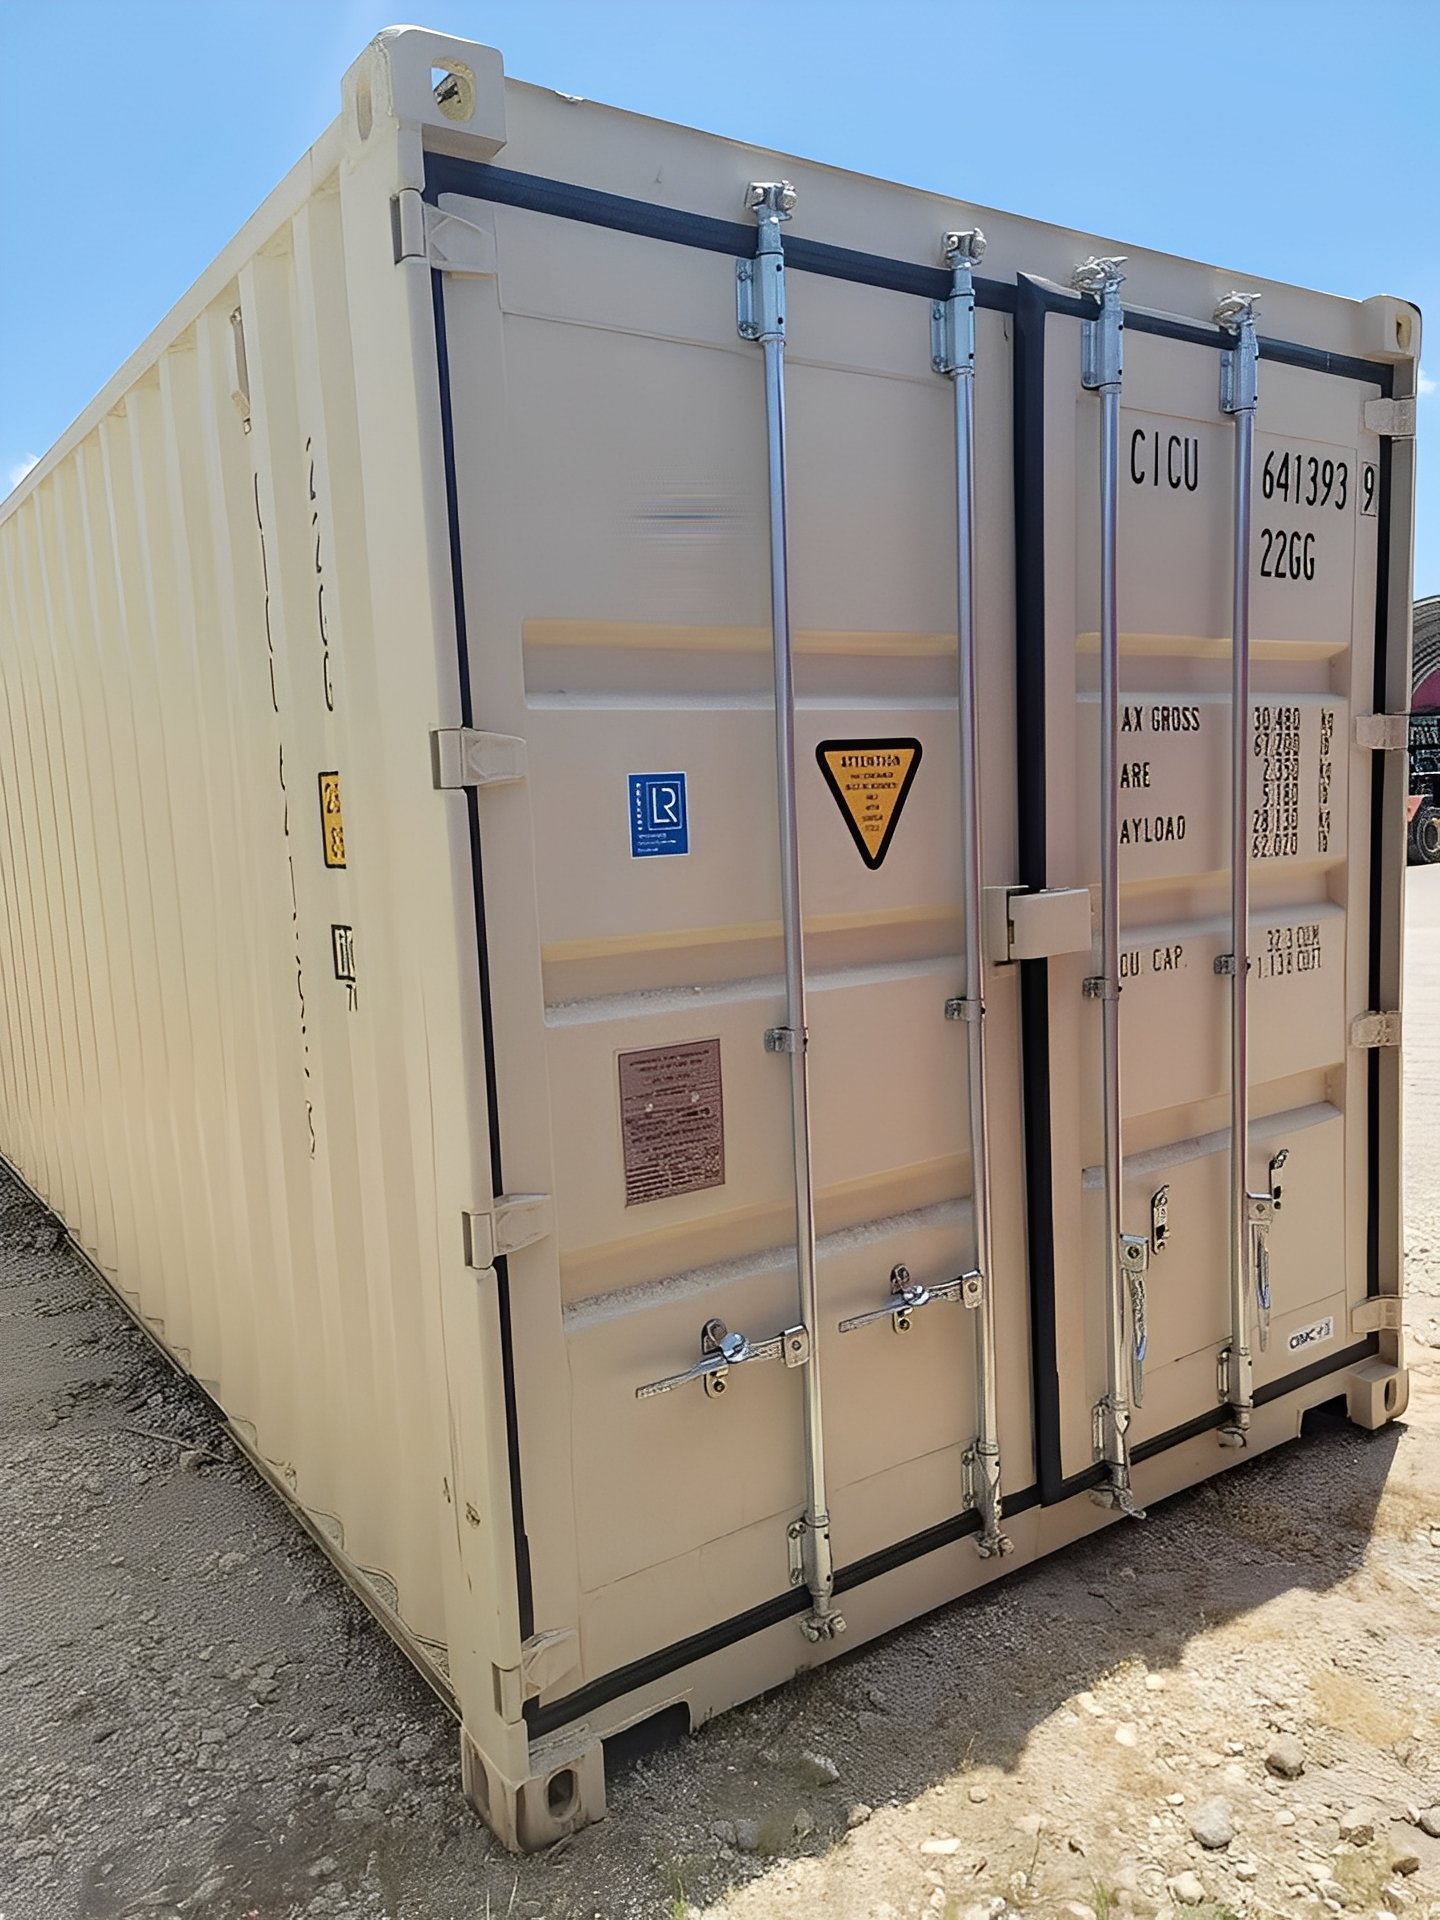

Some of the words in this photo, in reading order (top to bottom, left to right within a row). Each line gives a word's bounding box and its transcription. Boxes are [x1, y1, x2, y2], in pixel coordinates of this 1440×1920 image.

[1130, 428, 1199, 492] CICU
[1262, 450, 1349, 511] 641393
[1363, 464, 1376, 512] 9
[1260, 528, 1316, 581] 22GG
[1121, 705, 1144, 733] AX
[1151, 705, 1201, 732] GROSS
[1120, 761, 1151, 789] ARE
[1119, 815, 1186, 845] AYLOAD
